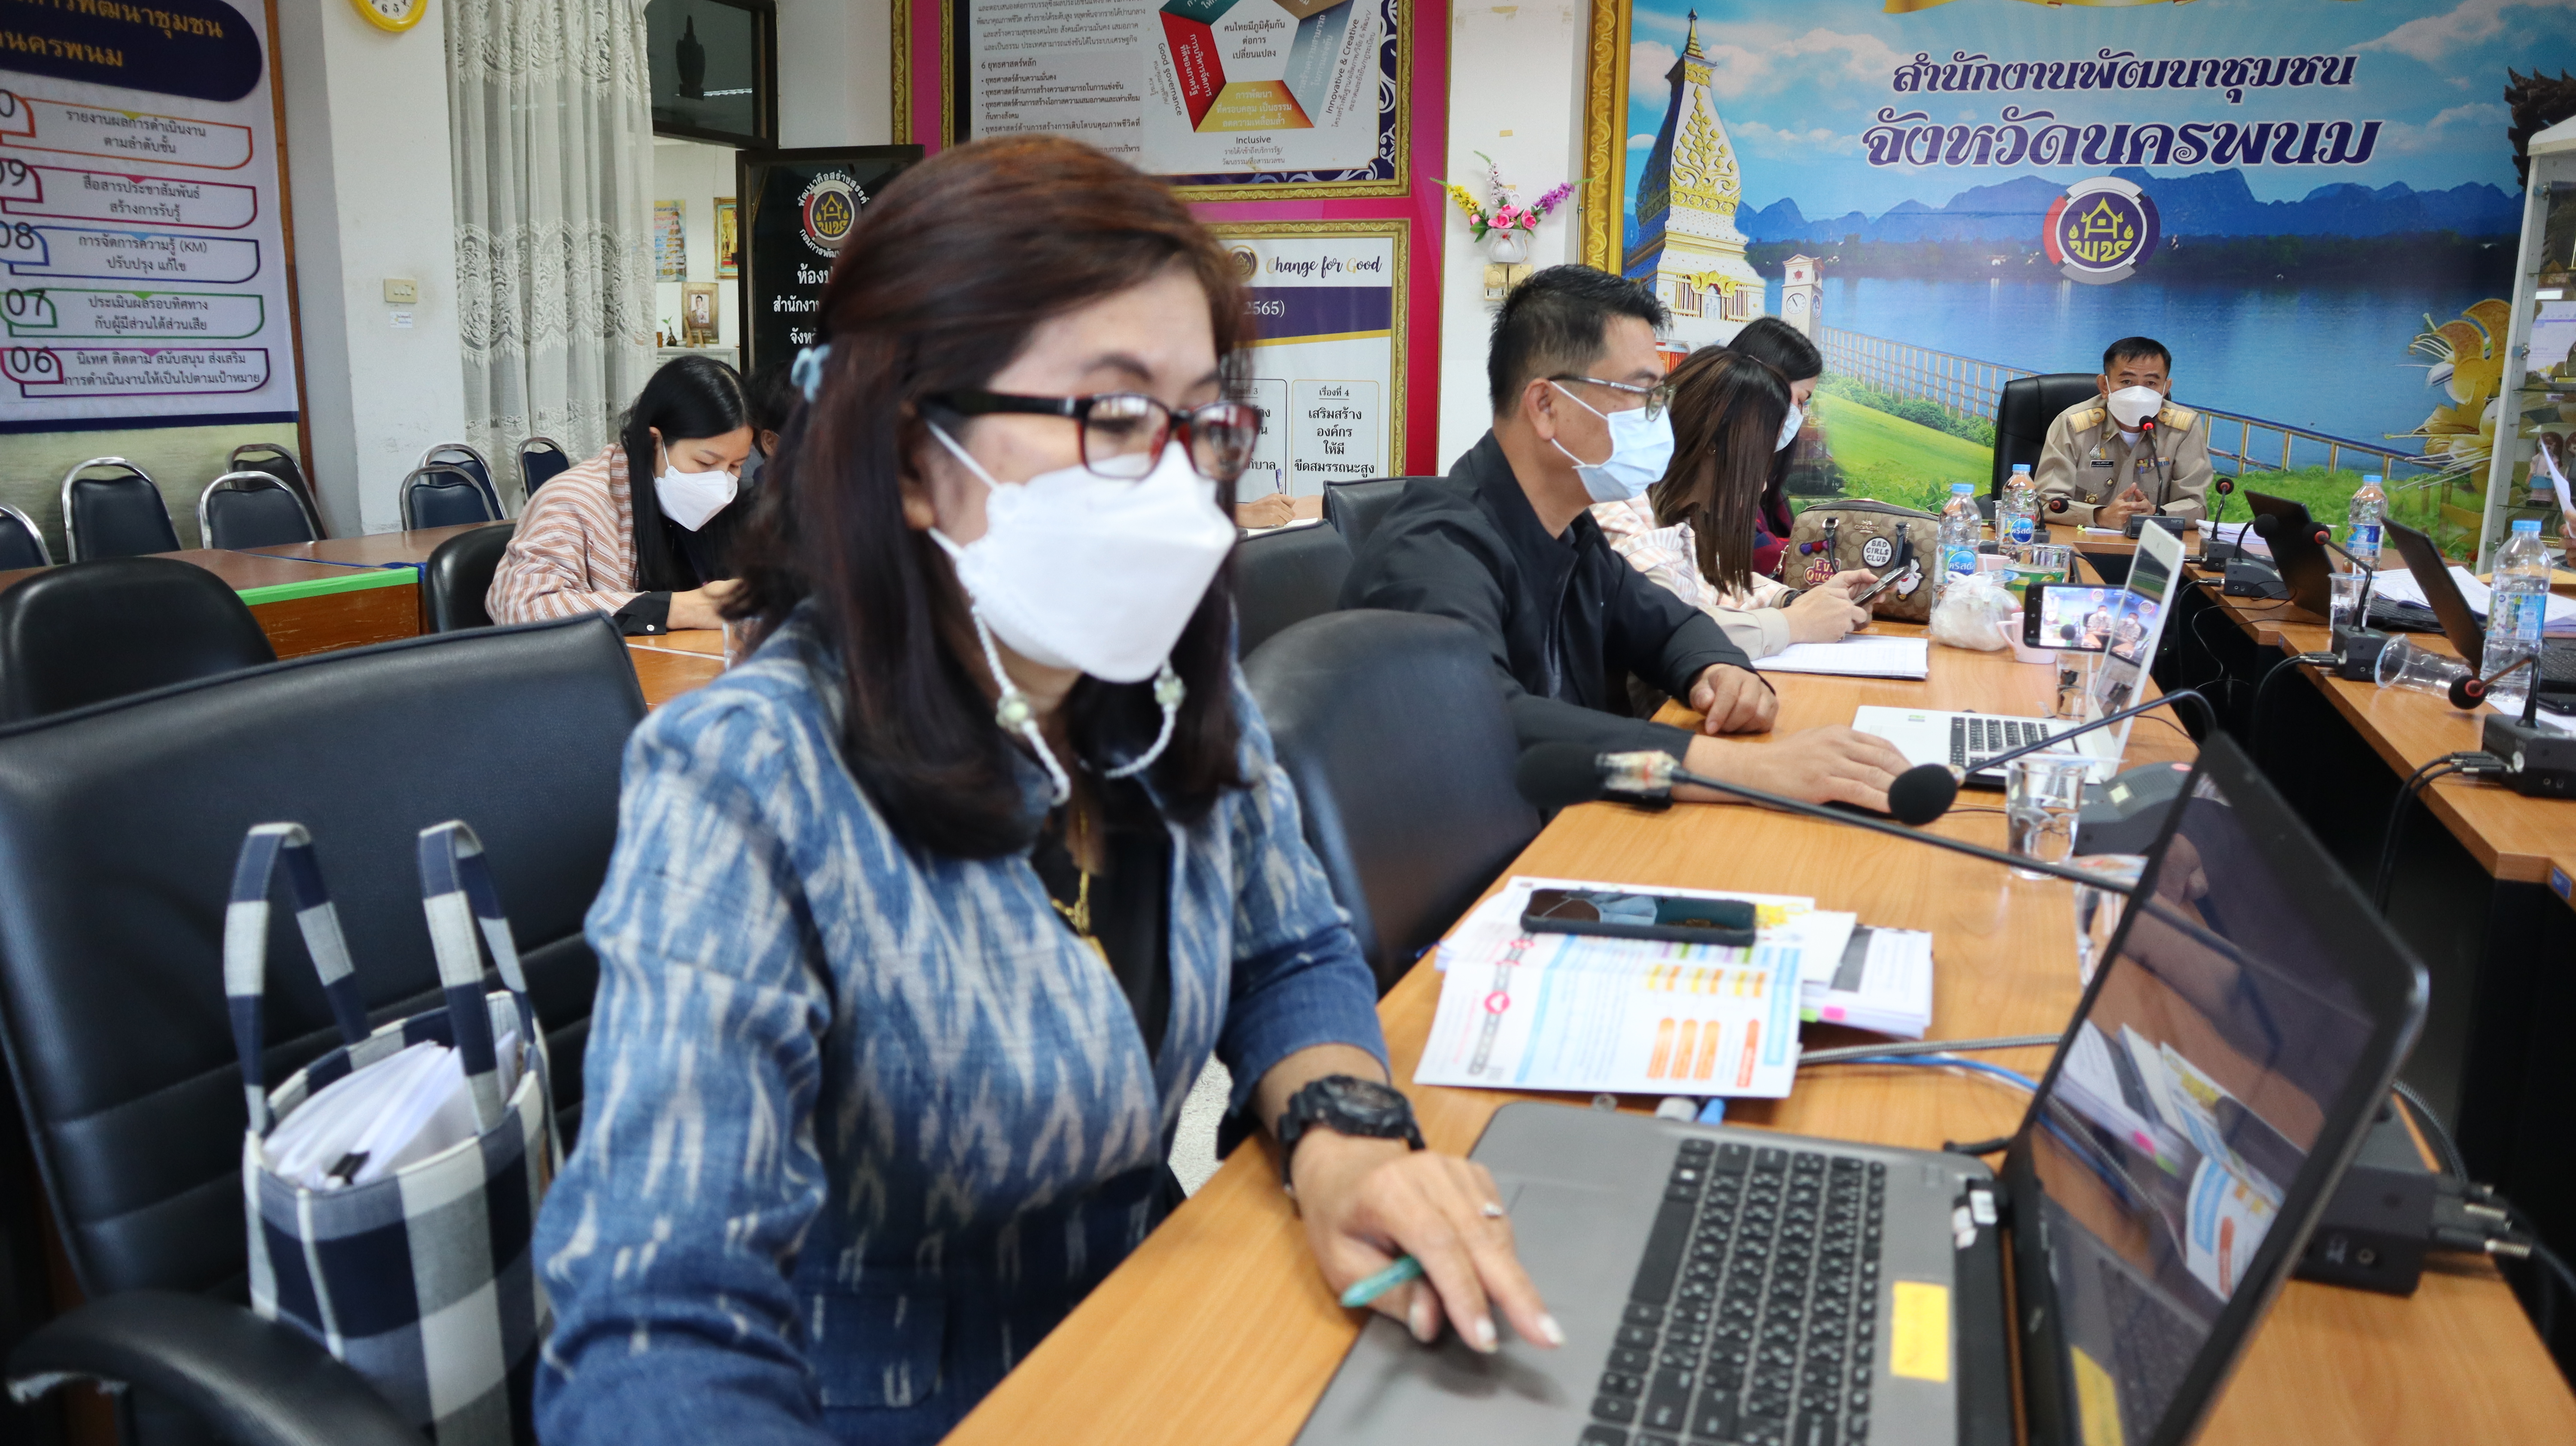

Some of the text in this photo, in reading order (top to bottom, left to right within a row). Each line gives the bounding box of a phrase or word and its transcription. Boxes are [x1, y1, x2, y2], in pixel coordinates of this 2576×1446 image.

[382, 3, 399, 13] 6 5
[1224, 21, 1285, 34] คนไทยมีภูมิคุ้มกัน
[0, 30, 124, 67] นครพนม
[984, 42, 1019, 51] และเป็นธรรม
[1242, 36, 1266, 45] ต่อการ
[1233, 48, 1276, 59] เปลี่ยนแปลง
[988, 58, 1036, 71] ยุทธศาสตร์หลัก
[1180, 44, 1200, 97] ที่ดีของภาครัฐ
[1190, 33, 1212, 97] การบริหารจัดการ
[1325, 67, 1345, 114] Innovative
[1343, 18, 1359, 55] Creative
[985, 71, 1057, 85] ยุทธศาสตร์ด้านความมั่นคง
[1158, 43, 1182, 116] Good governance
[1894, 49, 2357, 104] สำนักงานพัฒนาชุมชน
[1236, 88, 1273, 99] การพัฒนา
[985, 111, 1019, 120] กันทางสังคม
[1259, 102, 1292, 112] เป็นธรรม
[104, 135, 176, 154] ตามลำดับชั้น
[1236, 136, 1271, 144] Inclusive
[1863, 106, 2382, 166] จังหวัดนครพนม
[0, 159, 27, 186] 9
[83, 173, 200, 199] สื่อสารประชาสัมพันธ์
[797, 170, 870, 207] พัฒนาคือสร้างสรรค์
[110, 199, 181, 222] สร้างการรับรู้
[79, 233, 207, 255] การจัดการความรู้ (KM)
[107, 256, 186, 273] ปรับปรุง แก้ไข
[1266, 256, 1318, 278] Change
[1321, 256, 1343, 279] for
[1346, 256, 1382, 273] Good
[6, 288, 46, 316] 07
[95, 315, 207, 334] กับผู้มีส่วนได้ส่วนเสีย
[11, 346, 52, 374] 06
[76, 350, 246, 368] นิเทศ ติดตาม สนับสนุน ส่งเสริม
[1319, 386, 1342, 396] เรื่องที่
[1309, 407, 1361, 420] เสริมสร้าง
[1317, 424, 1353, 437] องค์กร
[1323, 440, 1344, 454] ให้มี
[1294, 459, 1374, 478] ขีดสมรรถนะสูง
[1866, 547, 1889, 556] GIRLS
[1867, 554, 1886, 563] CLUB
